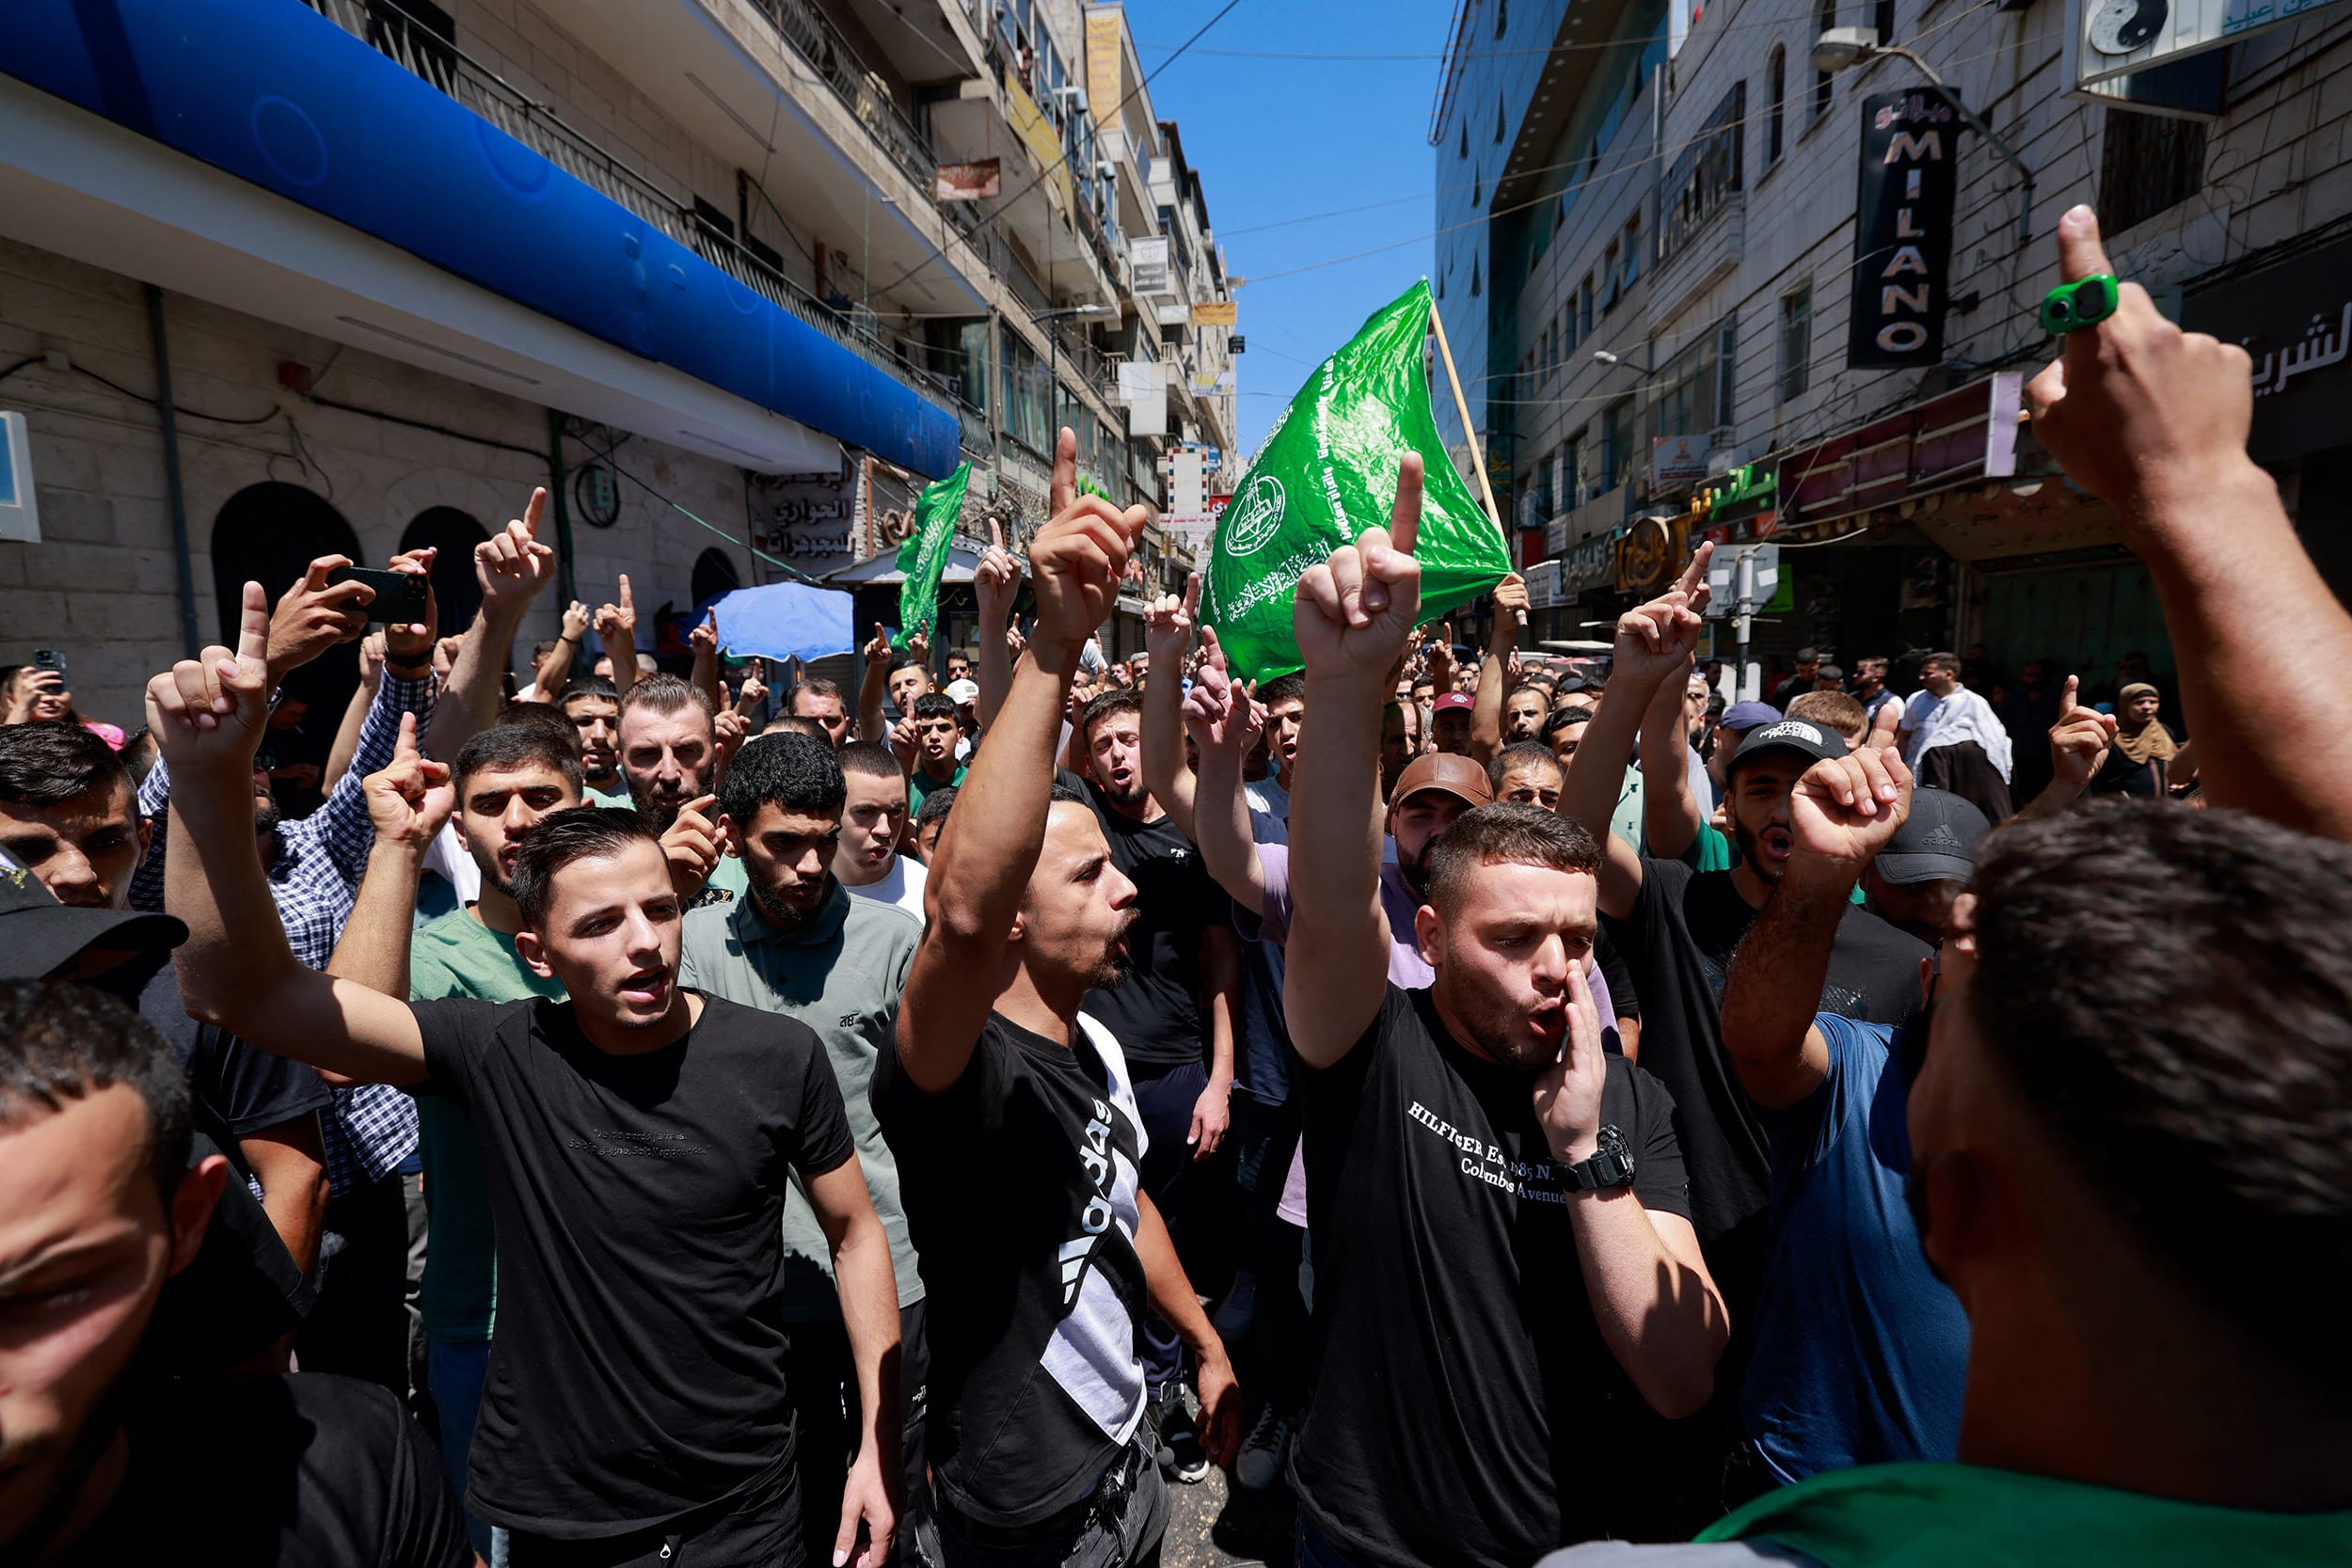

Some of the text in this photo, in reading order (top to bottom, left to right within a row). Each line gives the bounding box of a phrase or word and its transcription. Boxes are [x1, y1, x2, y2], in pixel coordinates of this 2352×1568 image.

[1876, 130, 1943, 352] MILANO
[1407, 1101, 1484, 1157] HILFIGER
[1517, 1182, 1565, 1204] Avenue
